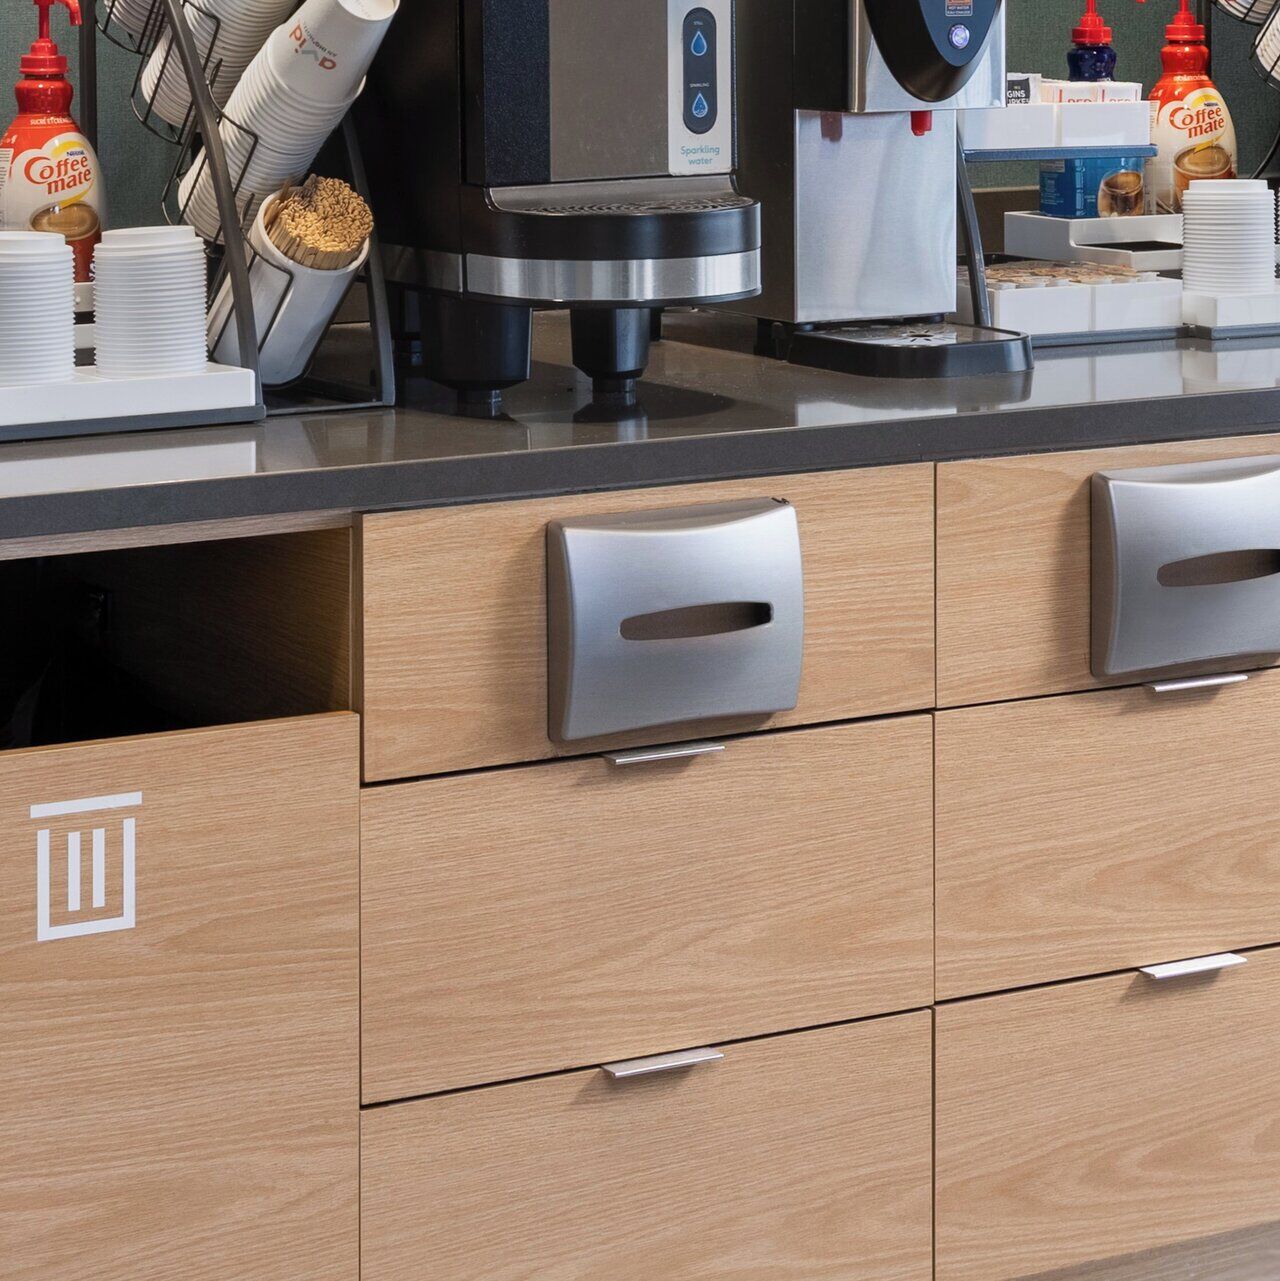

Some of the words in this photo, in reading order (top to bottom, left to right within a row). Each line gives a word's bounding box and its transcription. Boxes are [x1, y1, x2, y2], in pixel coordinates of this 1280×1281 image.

[289, 23, 337, 71] avid
[1169, 107, 1222, 131] Coffee
[1188, 117, 1225, 139] mate
[680, 146, 720, 157] Sparkling
[688, 157, 713, 165] water
[24, 156, 88, 185] Coffee
[47, 168, 91, 195] mate
